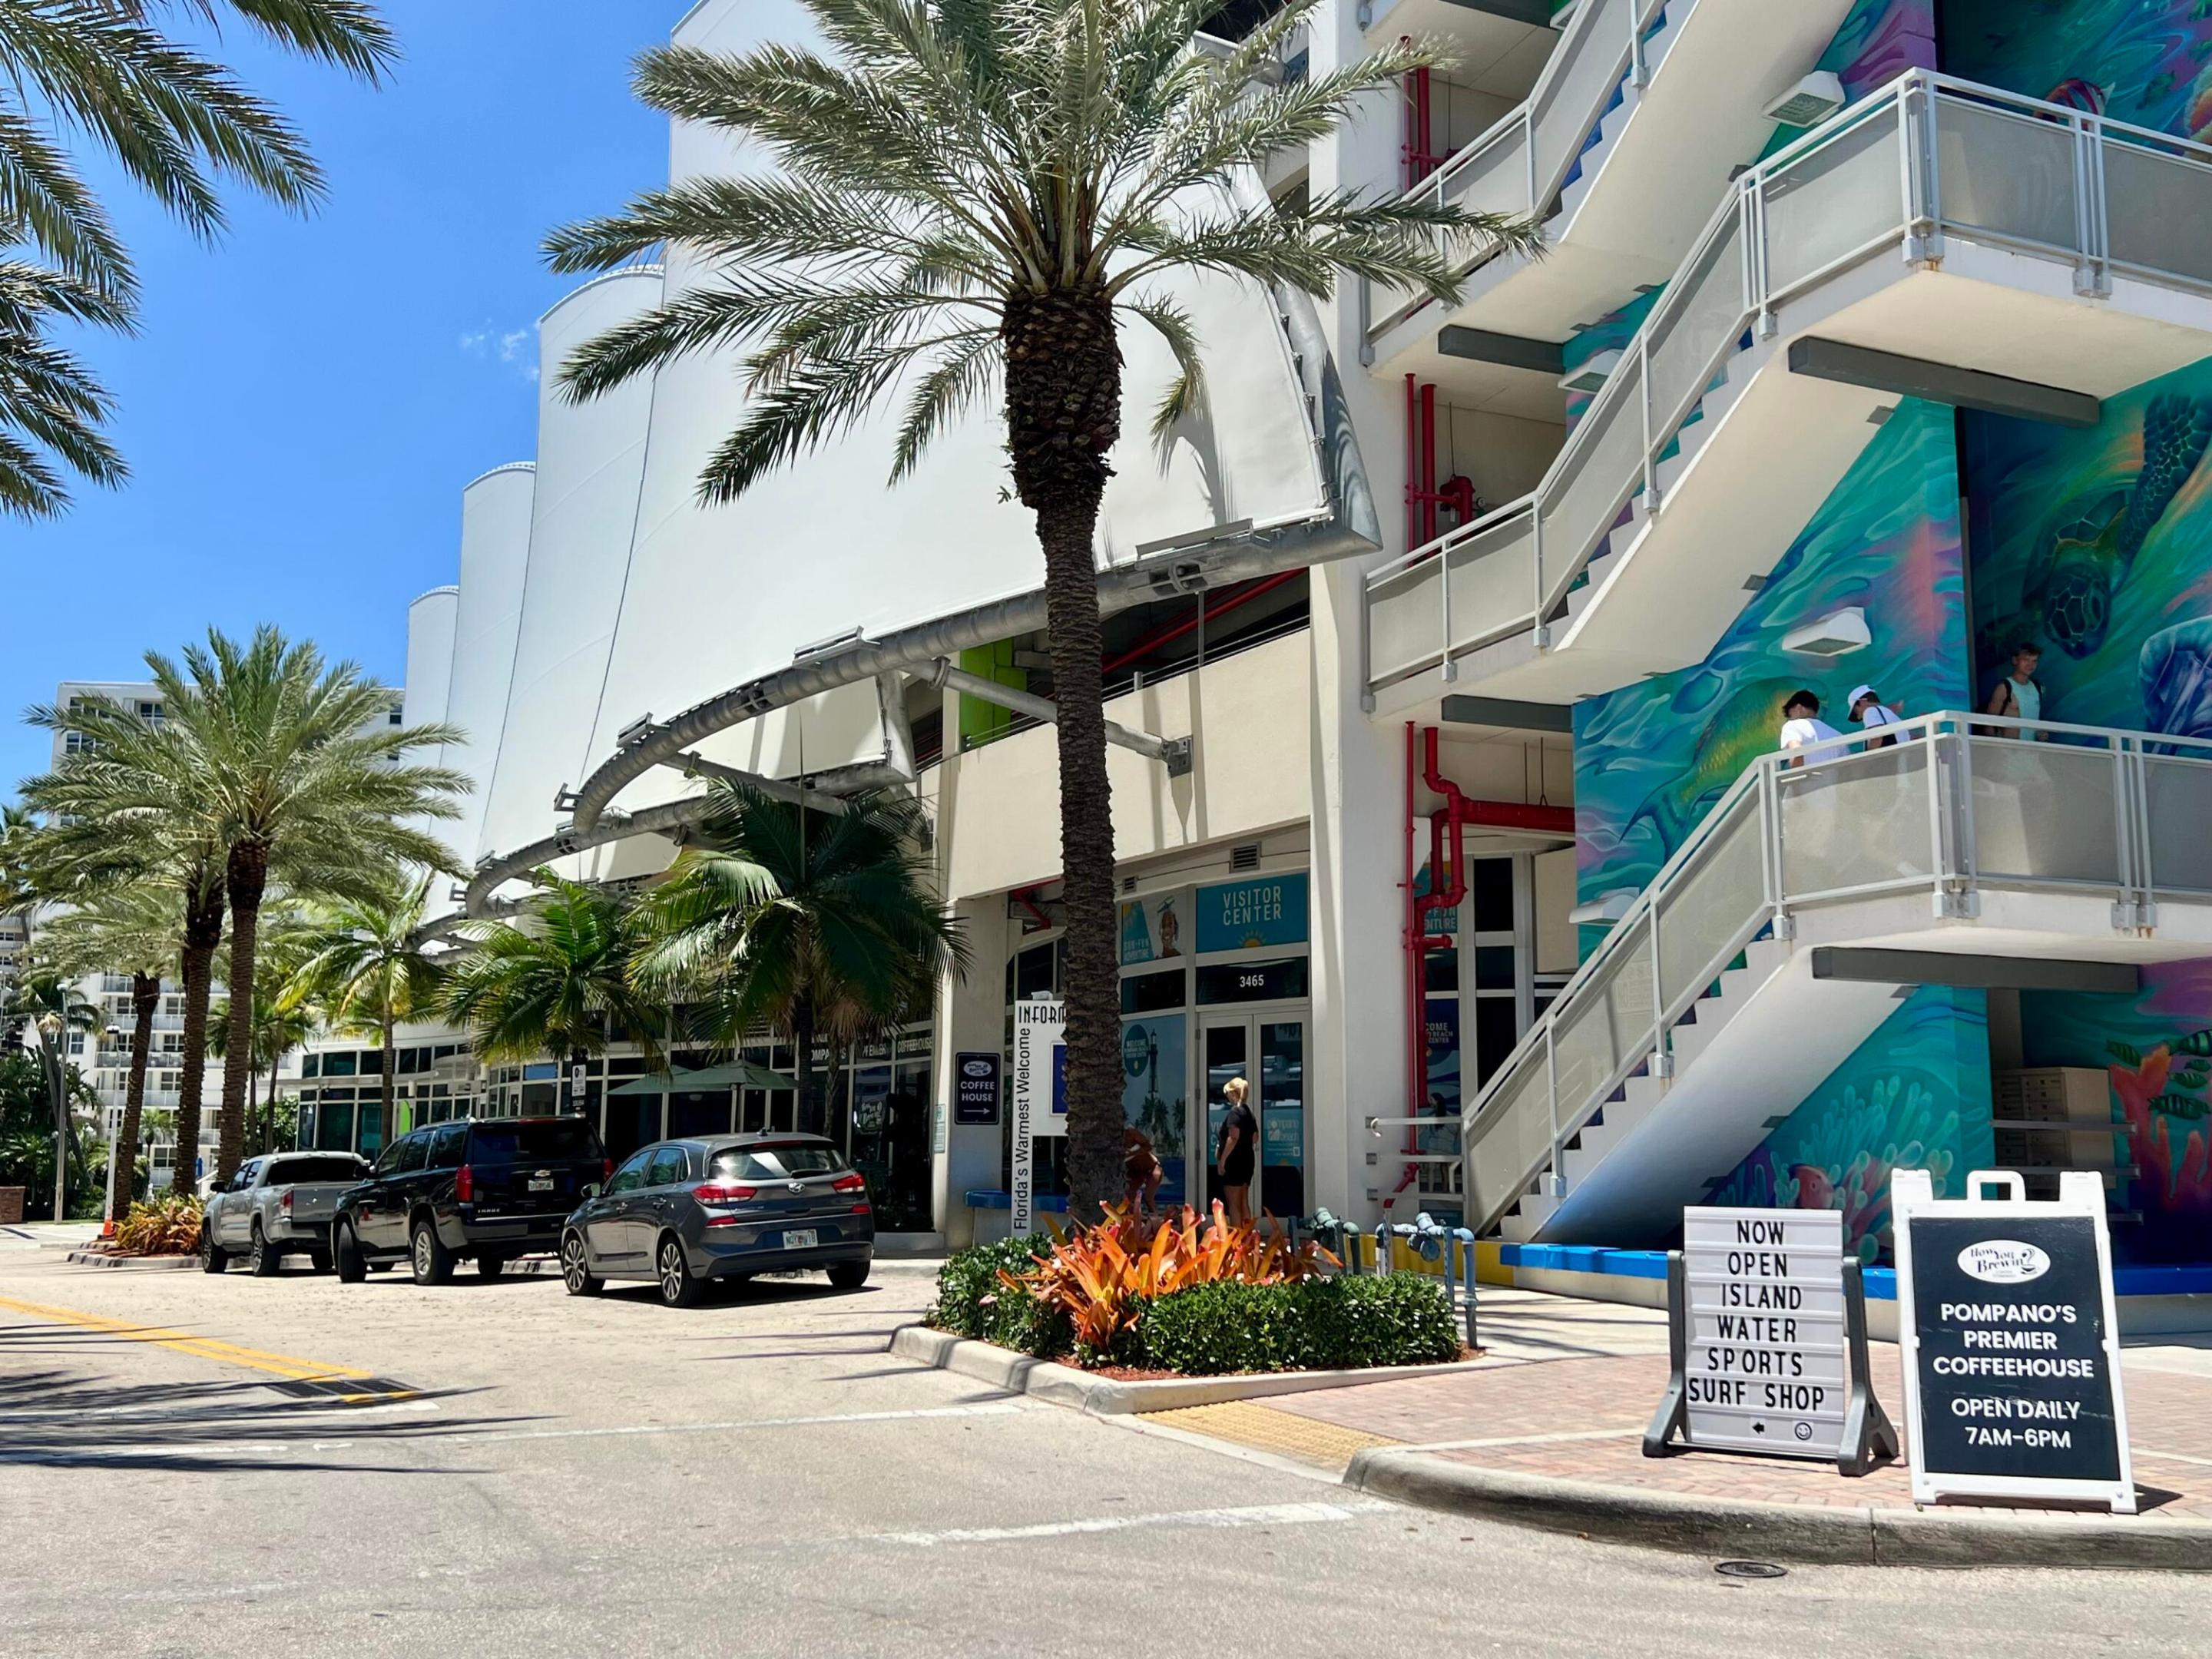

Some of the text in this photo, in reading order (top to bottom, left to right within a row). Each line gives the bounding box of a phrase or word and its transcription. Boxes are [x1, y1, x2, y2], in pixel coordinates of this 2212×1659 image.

[1223, 886, 1282, 908] VISITOR
[1223, 903, 1282, 926] CENTER
[1240, 975, 1264, 988] 3465
[1018, 1005, 1065, 1024] INFORM
[960, 1081, 995, 1090] COFFEE
[962, 1093, 993, 1102] HOUSE
[1014, 1028, 1030, 1230] Florida's Warmest Welcome
[1737, 1220, 1784, 1245] NOW
[1728, 1251, 1787, 1277] OPEN
[1721, 1283, 1802, 1310] ISLAND
[1941, 1303, 2077, 1323] POMPANO'S
[1717, 1315, 1797, 1343] WATER
[1963, 1330, 2058, 1349] PREMIER
[1707, 1347, 1803, 1376] SPORTS
[1932, 1356, 2094, 1378] COFFEEHOUSE
[1689, 1377, 1824, 1411] SURF SHOP
[1951, 1398, 2081, 1420] OPEN DAILY
[1965, 1426, 2071, 1449] 7AM-6PM
